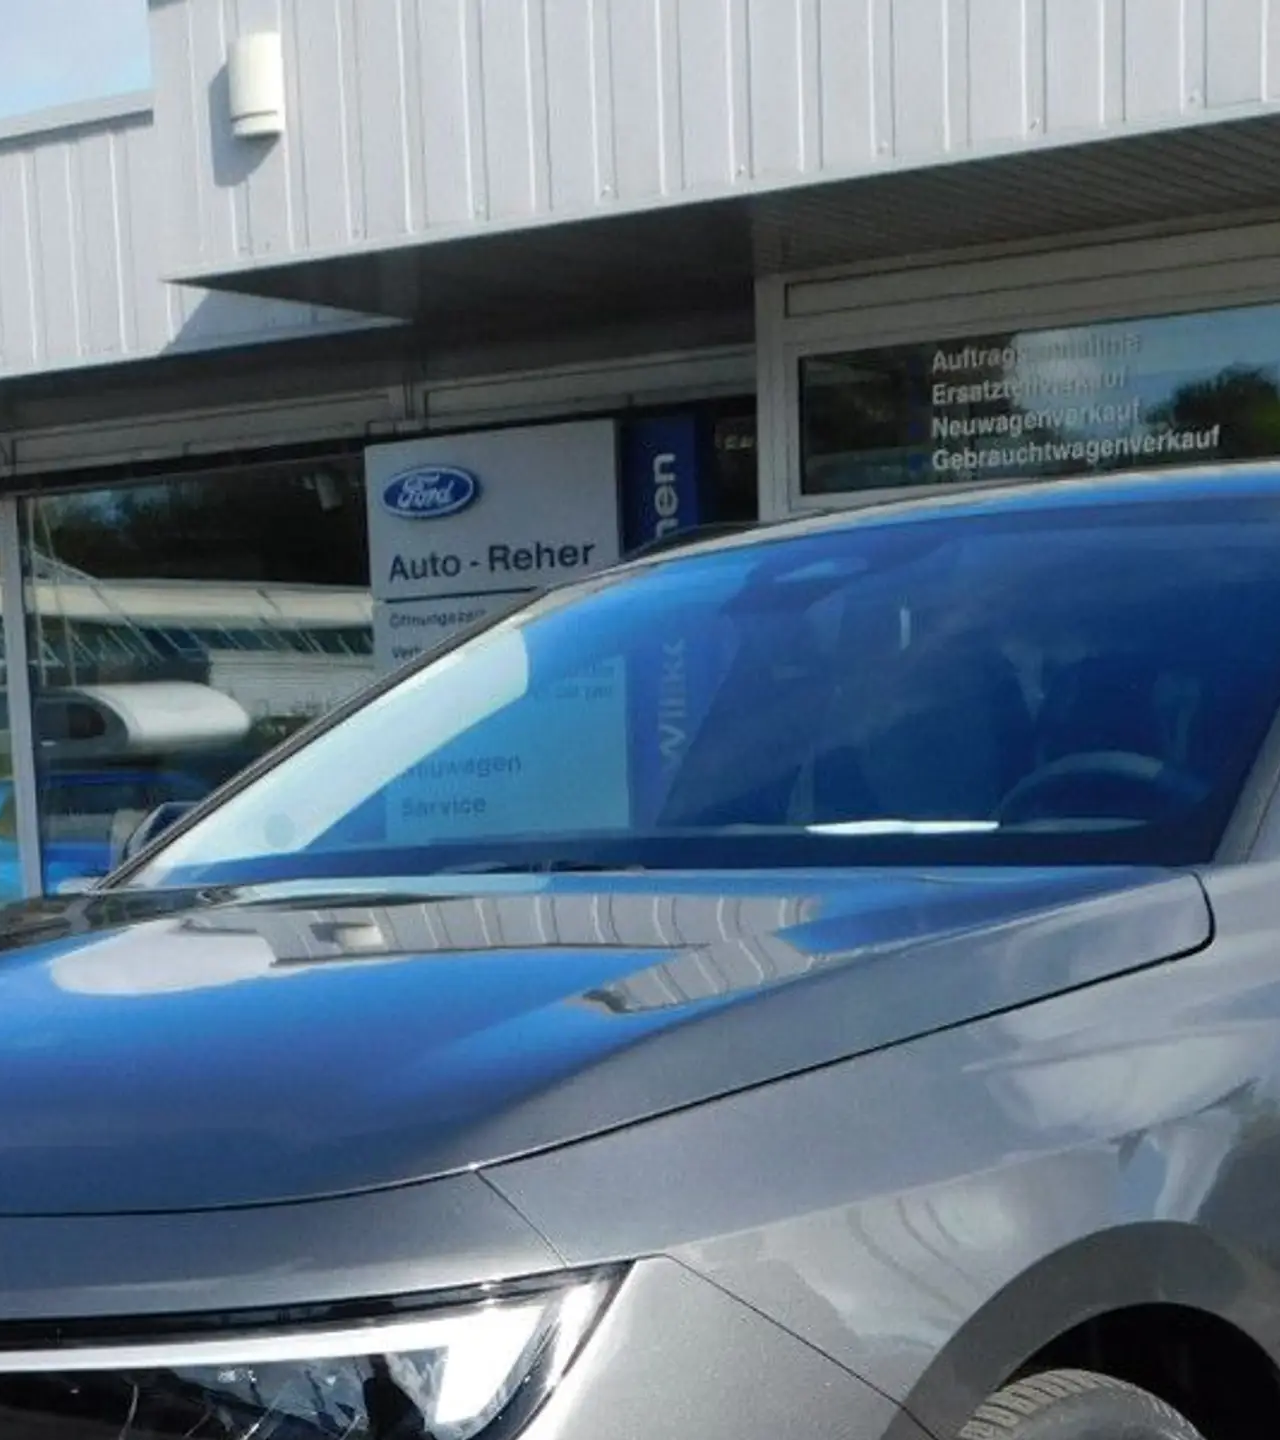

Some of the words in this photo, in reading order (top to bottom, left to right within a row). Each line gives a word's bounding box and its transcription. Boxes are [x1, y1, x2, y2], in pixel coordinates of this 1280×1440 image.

[932, 397, 1140, 438] Neuwagenverkauf
[932, 425, 1220, 470] Gebrauchtwagenverkauf
[397, 473, 455, 509] Ford
[389, 553, 461, 582] Auto
[488, 541, 596, 573] Reher
[402, 794, 487, 818] Service
